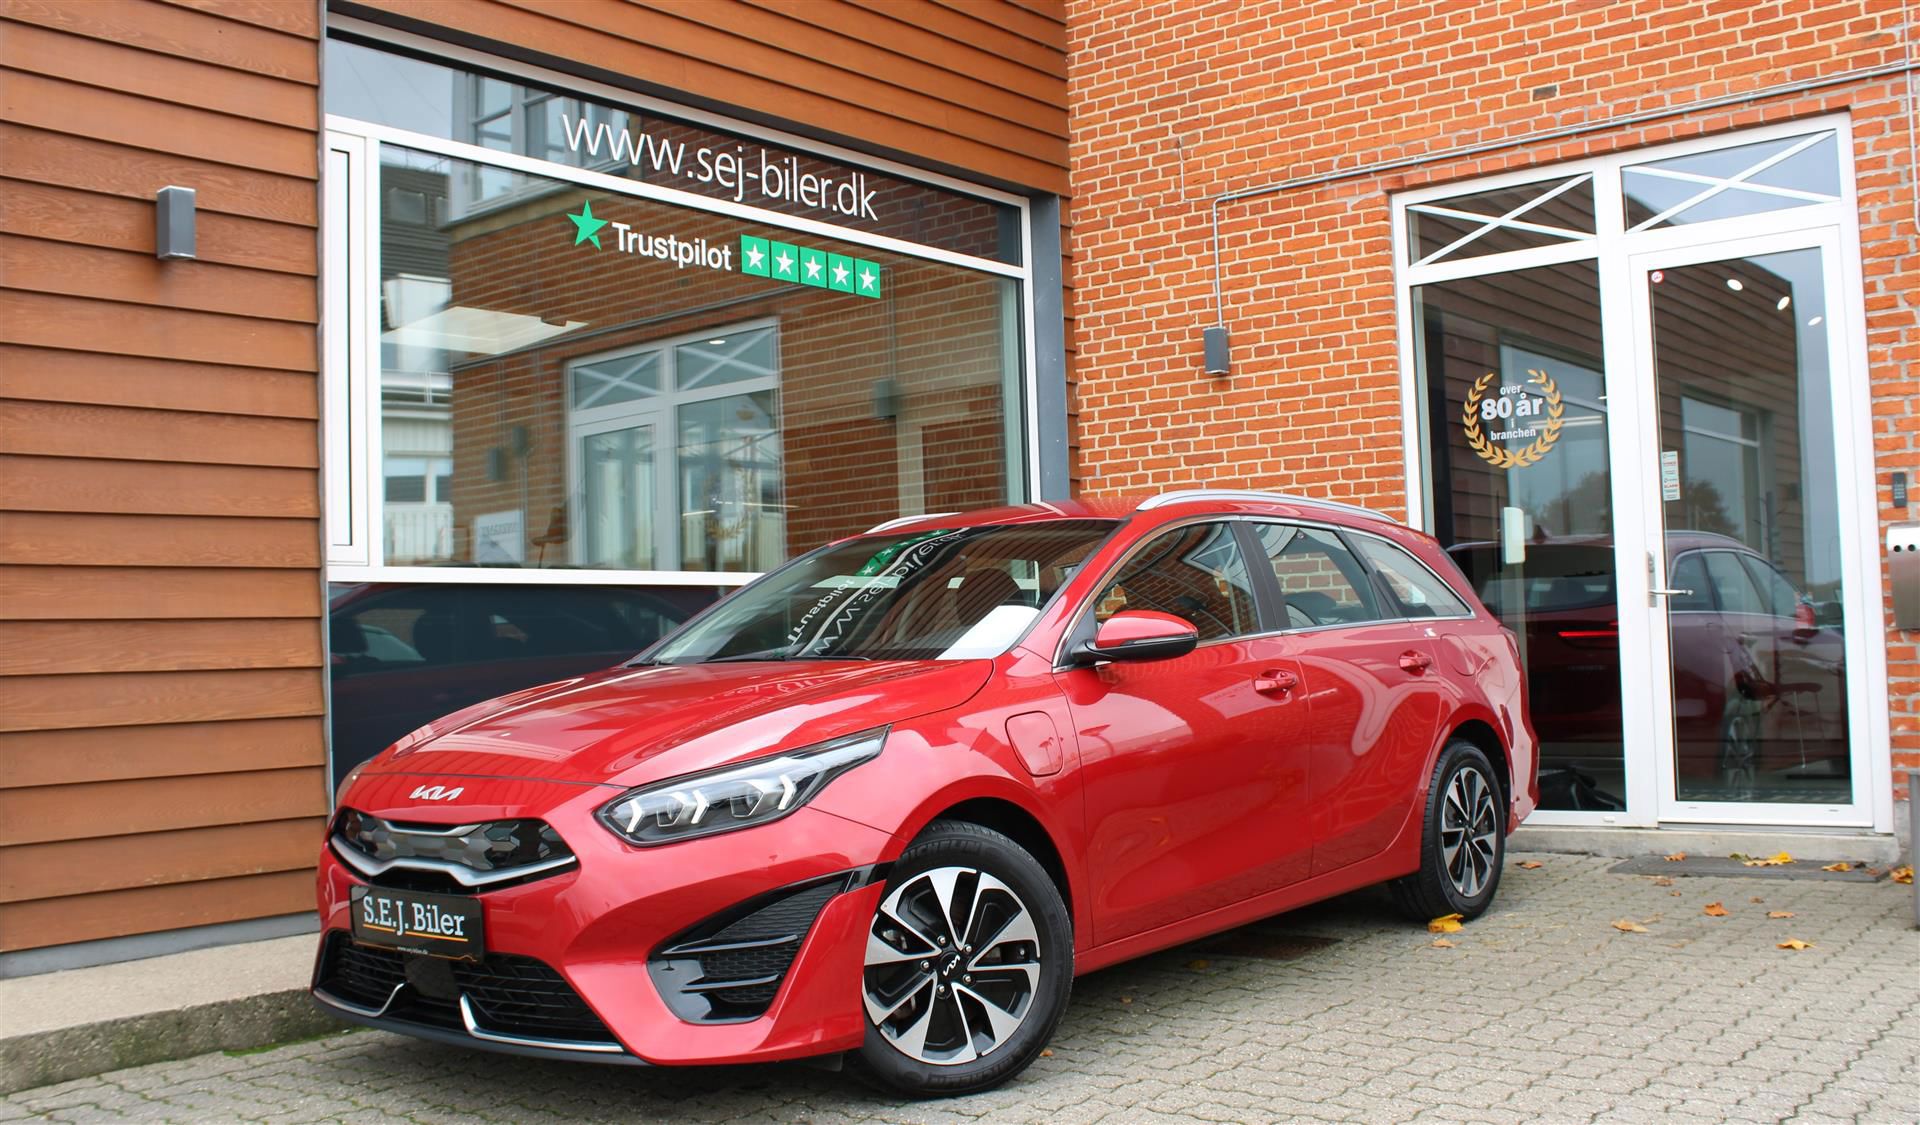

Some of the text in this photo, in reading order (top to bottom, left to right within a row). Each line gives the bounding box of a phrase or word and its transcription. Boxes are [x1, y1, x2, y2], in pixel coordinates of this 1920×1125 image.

[562, 113, 878, 221] www.sej-biler.dk
[612, 221, 732, 271] Trustpilot
[1481, 392, 1543, 420] 80 år
[1500, 385, 1522, 395] over
[1491, 428, 1536, 440] branchen
[363, 895, 465, 936] S.E.J. Biler
